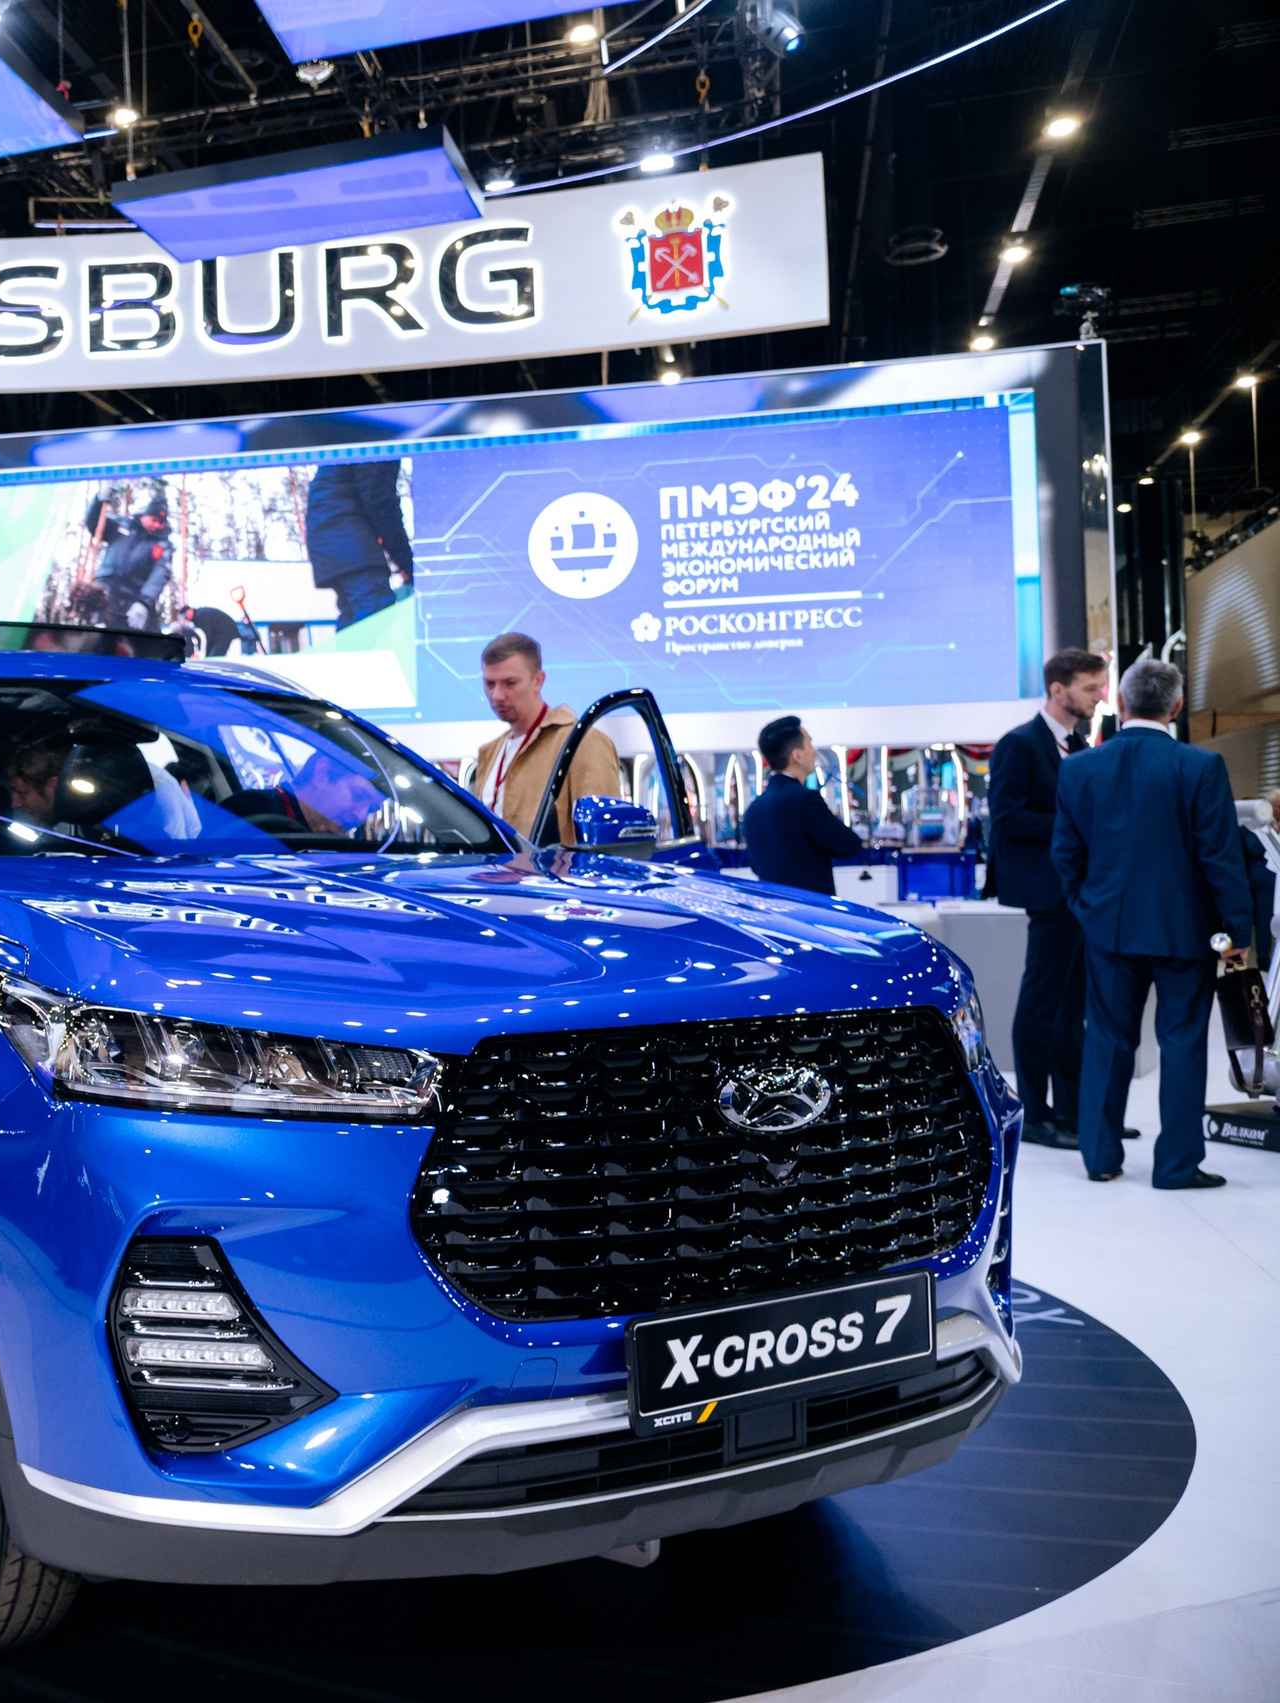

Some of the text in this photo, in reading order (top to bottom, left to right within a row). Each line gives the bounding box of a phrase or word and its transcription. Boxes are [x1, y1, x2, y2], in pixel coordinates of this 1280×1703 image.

[661, 511, 830, 541] ПЕТЕРБУРГСКИЙ
[661, 527, 861, 559] МЕЖДУНАРОДНЫЙ
[661, 548, 855, 578] ЭКОНОМИЧЕСКИЙ
[662, 576, 739, 596] ФОРУМ
[664, 606, 863, 636] РОСКОНГРЕСС
[660, 1294, 912, 1390] X-CROSS 7
[653, 1410, 693, 1428] XCITE
